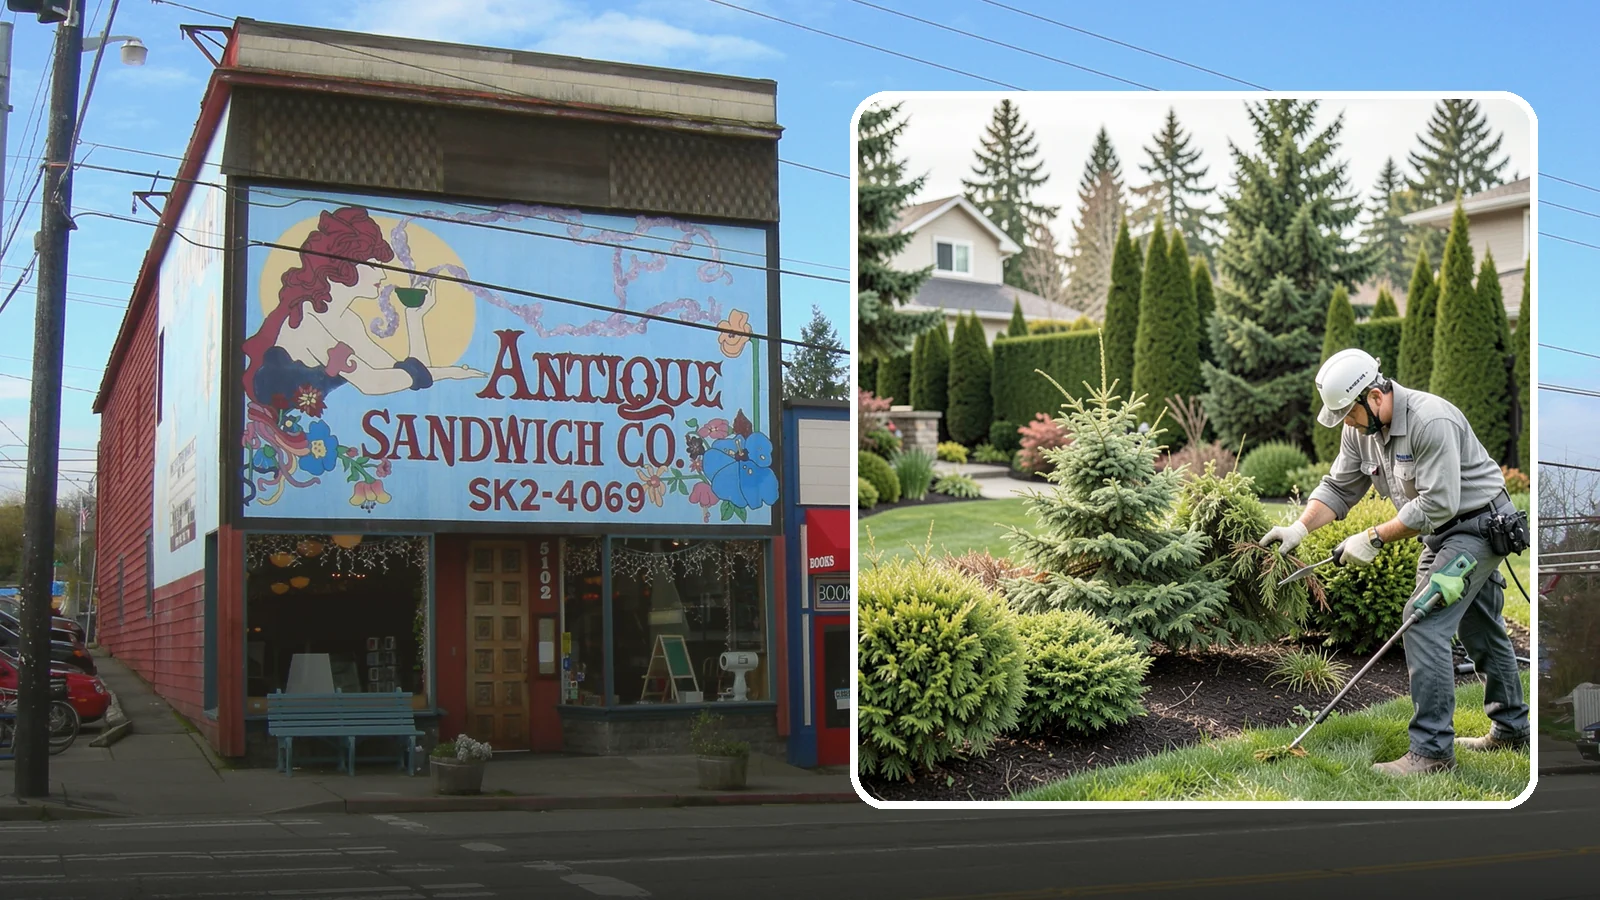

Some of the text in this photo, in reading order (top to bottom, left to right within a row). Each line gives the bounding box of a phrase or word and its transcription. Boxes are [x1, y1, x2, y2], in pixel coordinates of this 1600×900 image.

[476, 328, 724, 420] ANTIQUE
[361, 408, 684, 469] SANDWICH CO.
[468, 477, 646, 513] SK2-4069
[540, 541, 551, 599] 5102
[809, 555, 835, 569] BOOKS
